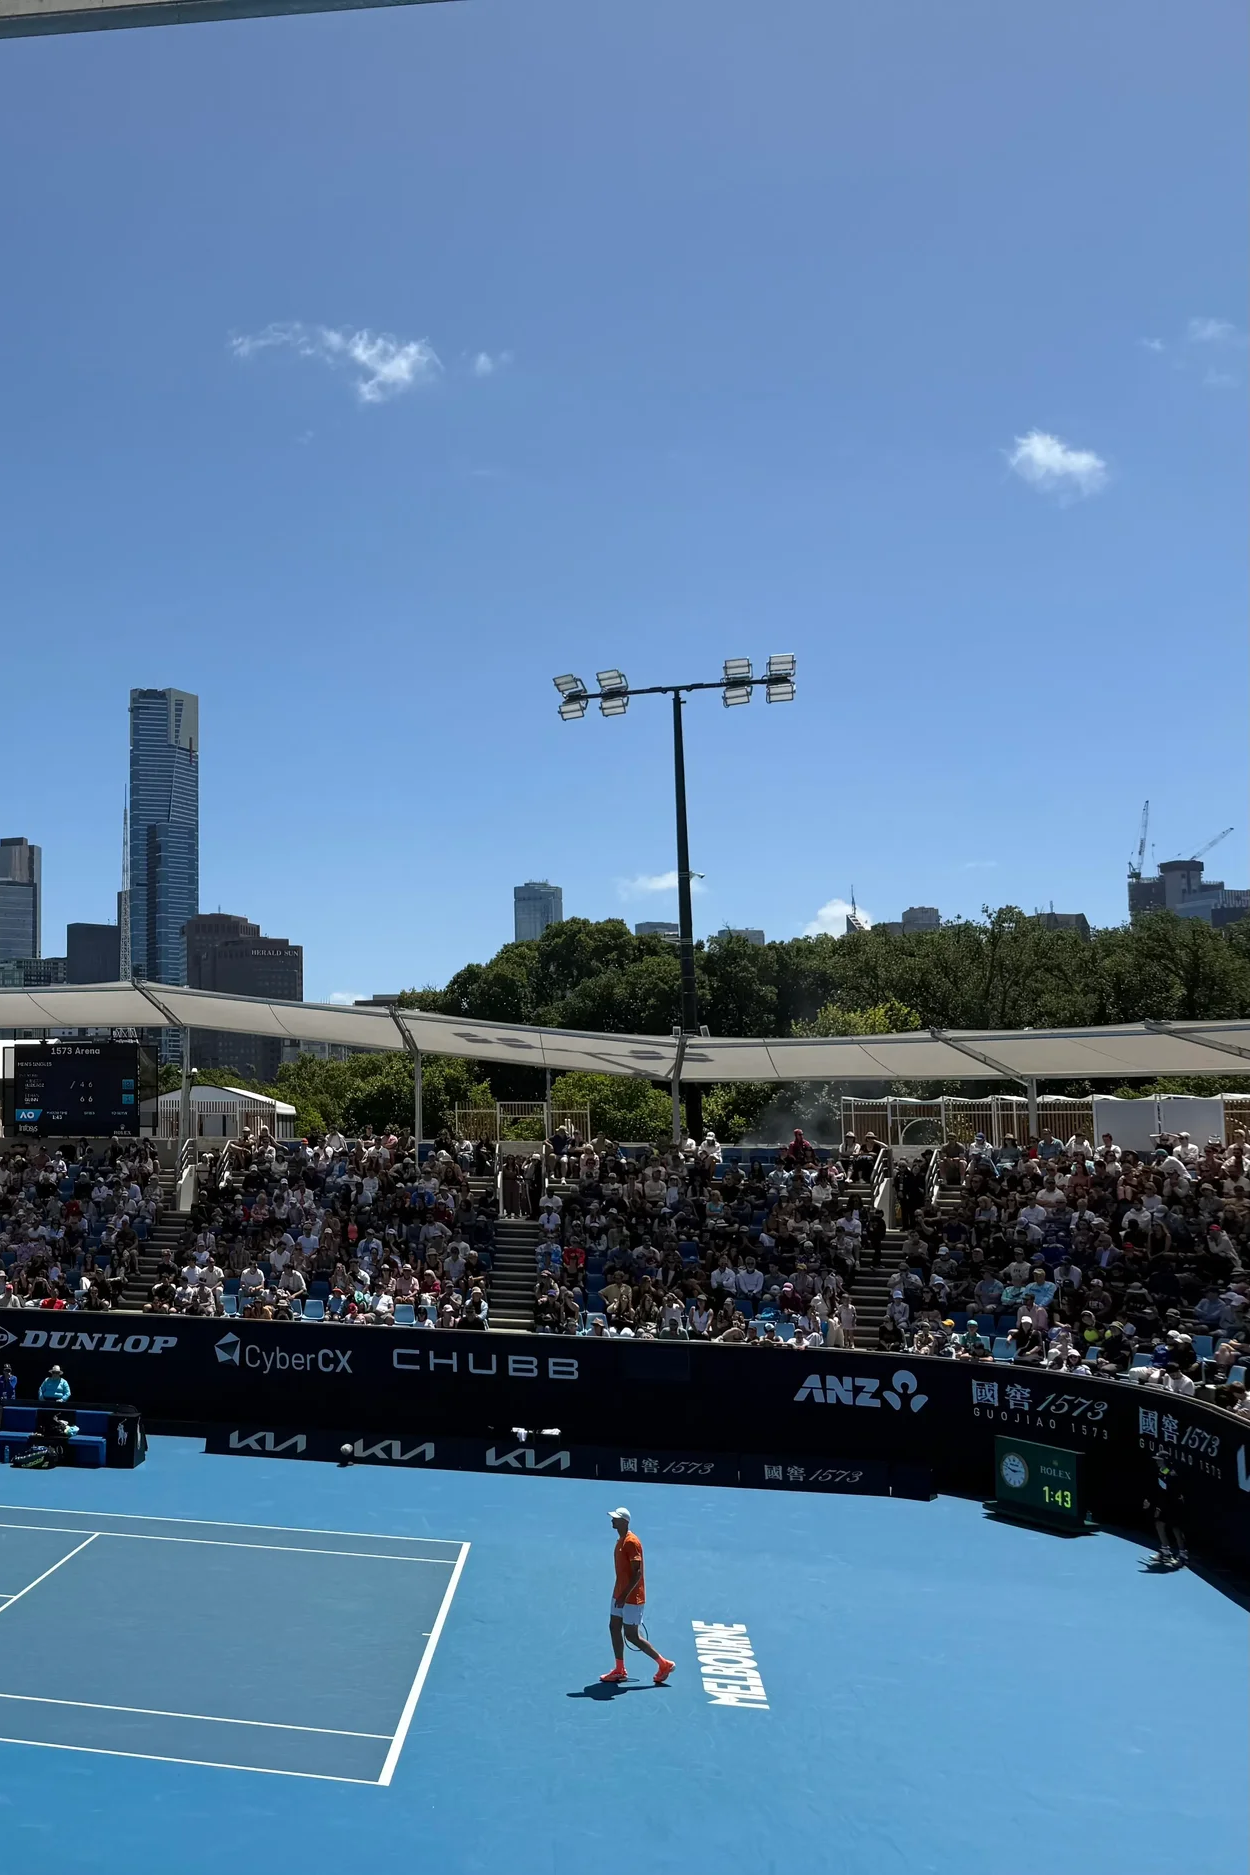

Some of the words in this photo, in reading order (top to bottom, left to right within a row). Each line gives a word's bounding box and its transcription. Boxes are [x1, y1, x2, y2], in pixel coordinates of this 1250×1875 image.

[50, 1046, 73, 1055] 1573
[74, 1046, 101, 1055] Arena
[19, 1111, 35, 1119] AO
[18, 1124, 38, 1133] Infosys
[19, 1329, 178, 1354] DUNLOP
[245, 1344, 353, 1374] CyberCX
[392, 1348, 579, 1380] CHUBB
[793, 1373, 881, 1408] ANZ
[973, 1407, 1057, 1429] GUOJIAO
[1071, 1422, 1109, 1440] 1573
[229, 1429, 307, 1453] KIA
[354, 1438, 435, 1462] KIA
[485, 1446, 571, 1471] KIA
[1040, 1465, 1072, 1480] ROLEX
[1042, 1485, 1072, 1508] 1:43
[691, 1619, 771, 1710] MELBOURNE
